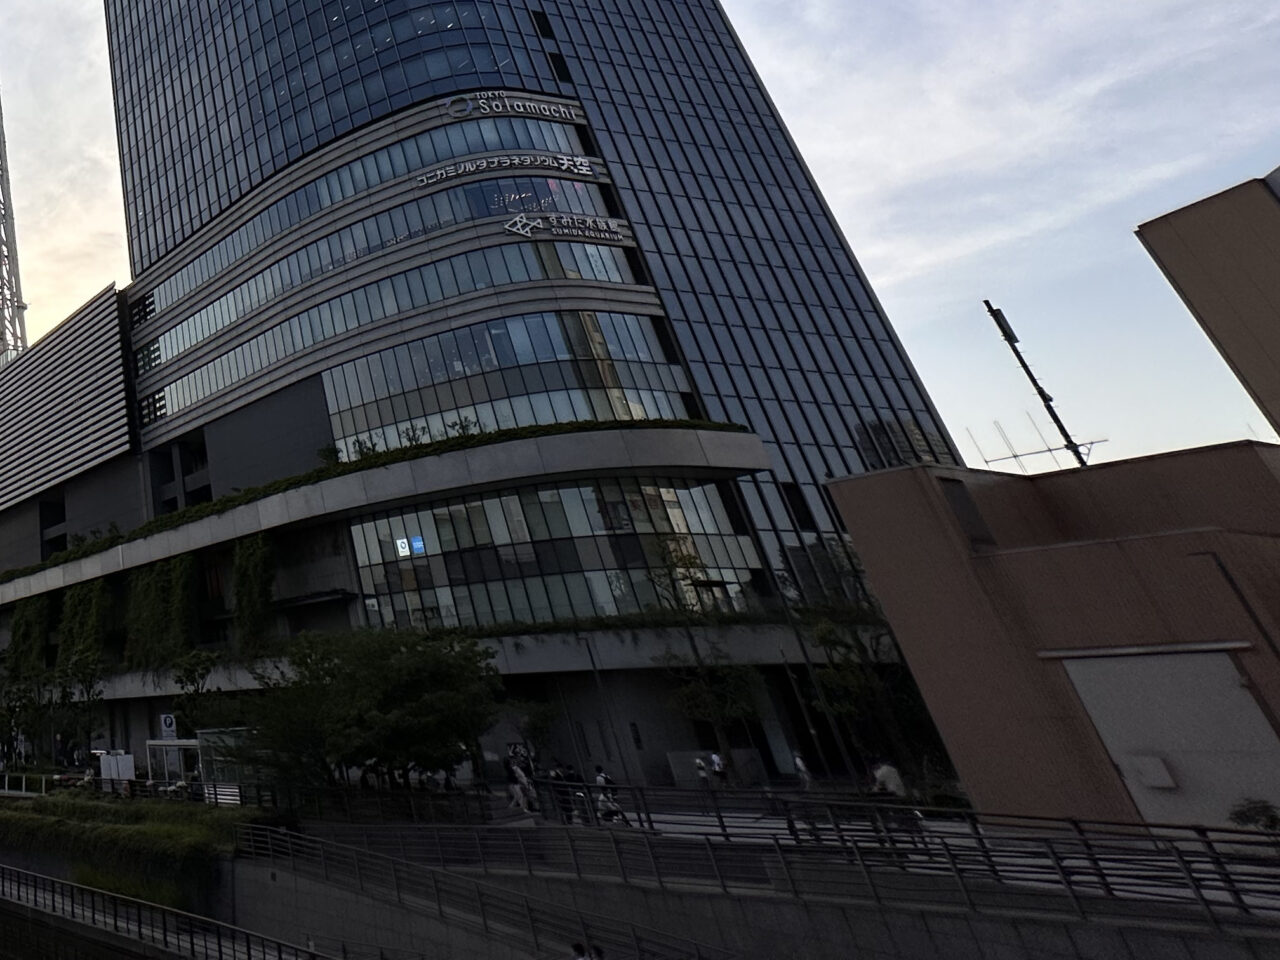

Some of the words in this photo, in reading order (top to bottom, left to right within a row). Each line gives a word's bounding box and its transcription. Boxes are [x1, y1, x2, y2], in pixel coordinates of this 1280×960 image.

[475, 90, 506, 100] TOKYO
[479, 99, 577, 120] Solamachi
[551, 228, 584, 237] SUMIDA
[584, 230, 624, 241] AQUARIUM
